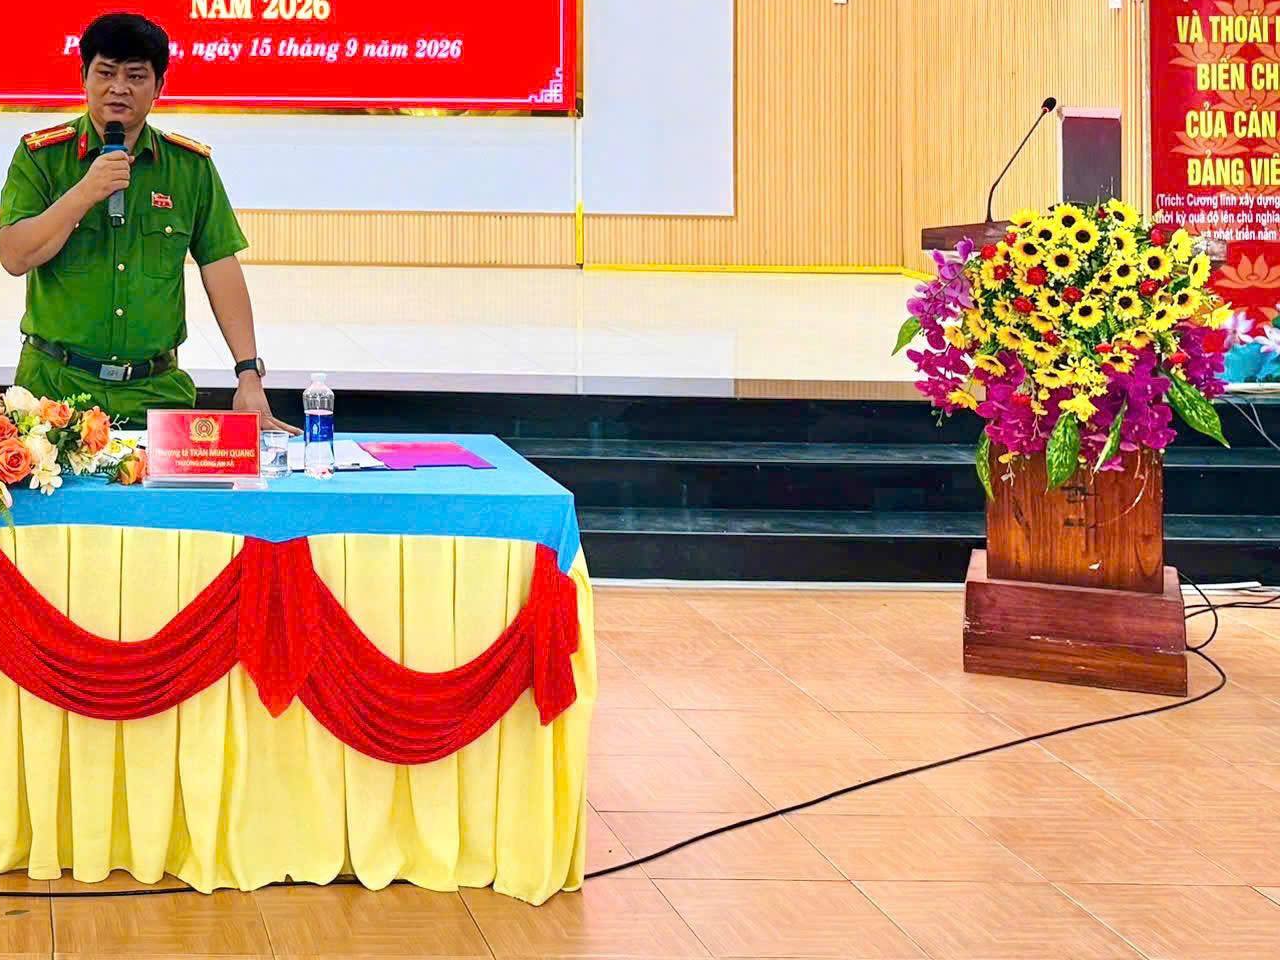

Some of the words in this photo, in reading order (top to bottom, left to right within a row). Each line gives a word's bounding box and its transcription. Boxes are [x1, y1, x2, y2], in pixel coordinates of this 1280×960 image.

[1176, 9, 1204, 43] VÀ
[1209, 10, 1269, 43] THOÁI
[192, 37, 242, 60] ngày
[249, 38, 271, 56] 15
[278, 38, 340, 62] tháng
[345, 39, 357, 57] 9
[363, 40, 407, 57] năm
[415, 39, 462, 58] 2026
[1197, 55, 1245, 91] BIẾN
[1251, 63, 1280, 91] CH
[1185, 101, 1228, 139] CỦA
[1233, 104, 1276, 139] CÁN
[1187, 149, 1245, 186] ĐẢNG
[1251, 152, 1280, 186] VIÊ
